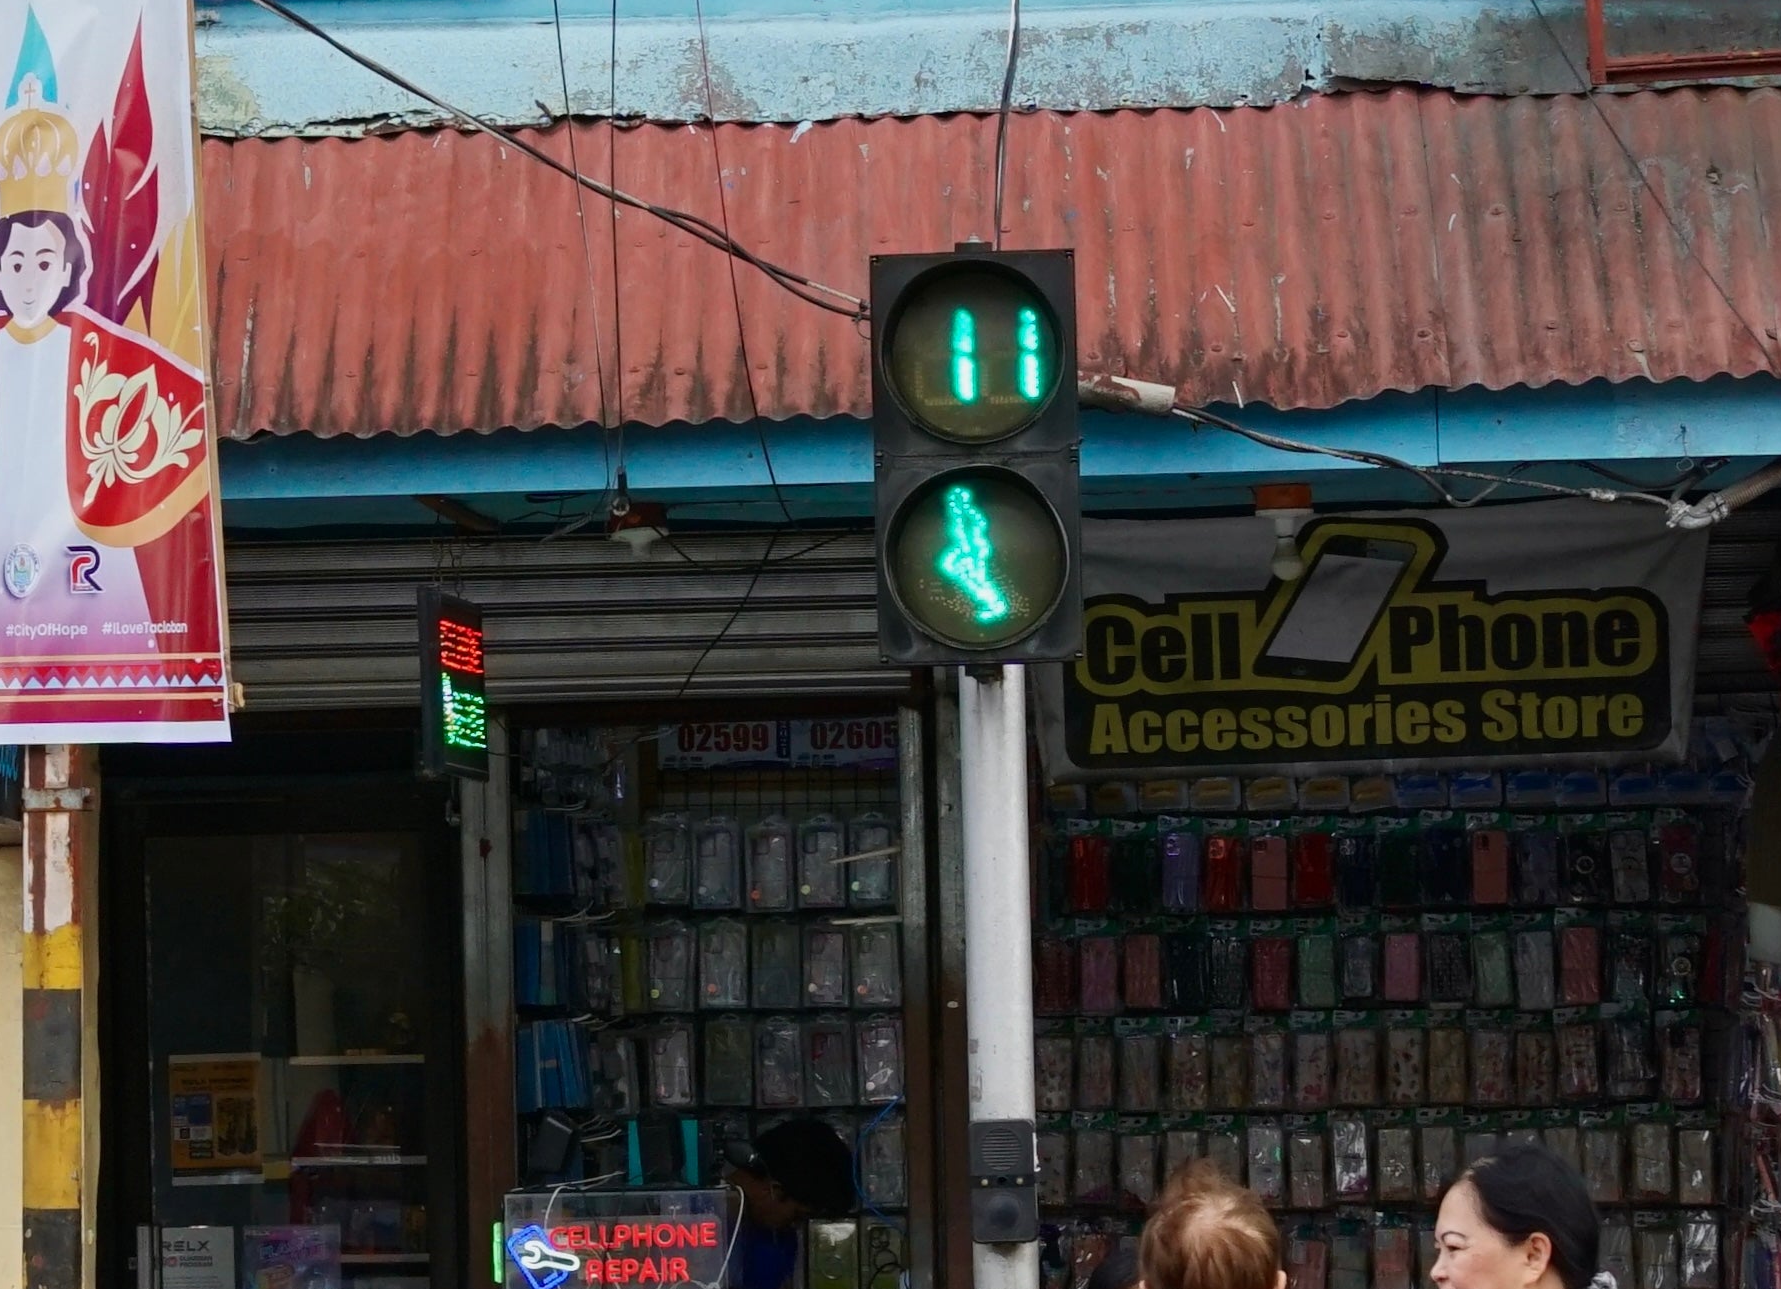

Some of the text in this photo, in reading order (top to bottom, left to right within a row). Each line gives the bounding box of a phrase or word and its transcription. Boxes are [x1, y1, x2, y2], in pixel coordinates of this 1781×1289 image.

[6, 622, 88, 640] #CityOfHope
[1085, 599, 1642, 686] Cell Phone
[810, 720, 899, 751] 02605
[1089, 687, 1645, 755] Accessories Store
[677, 722, 770, 752] 02599
[161, 1240, 210, 1252] RELX
[549, 1222, 718, 1252] CELLPHONE
[585, 1257, 691, 1285] REPAIR
